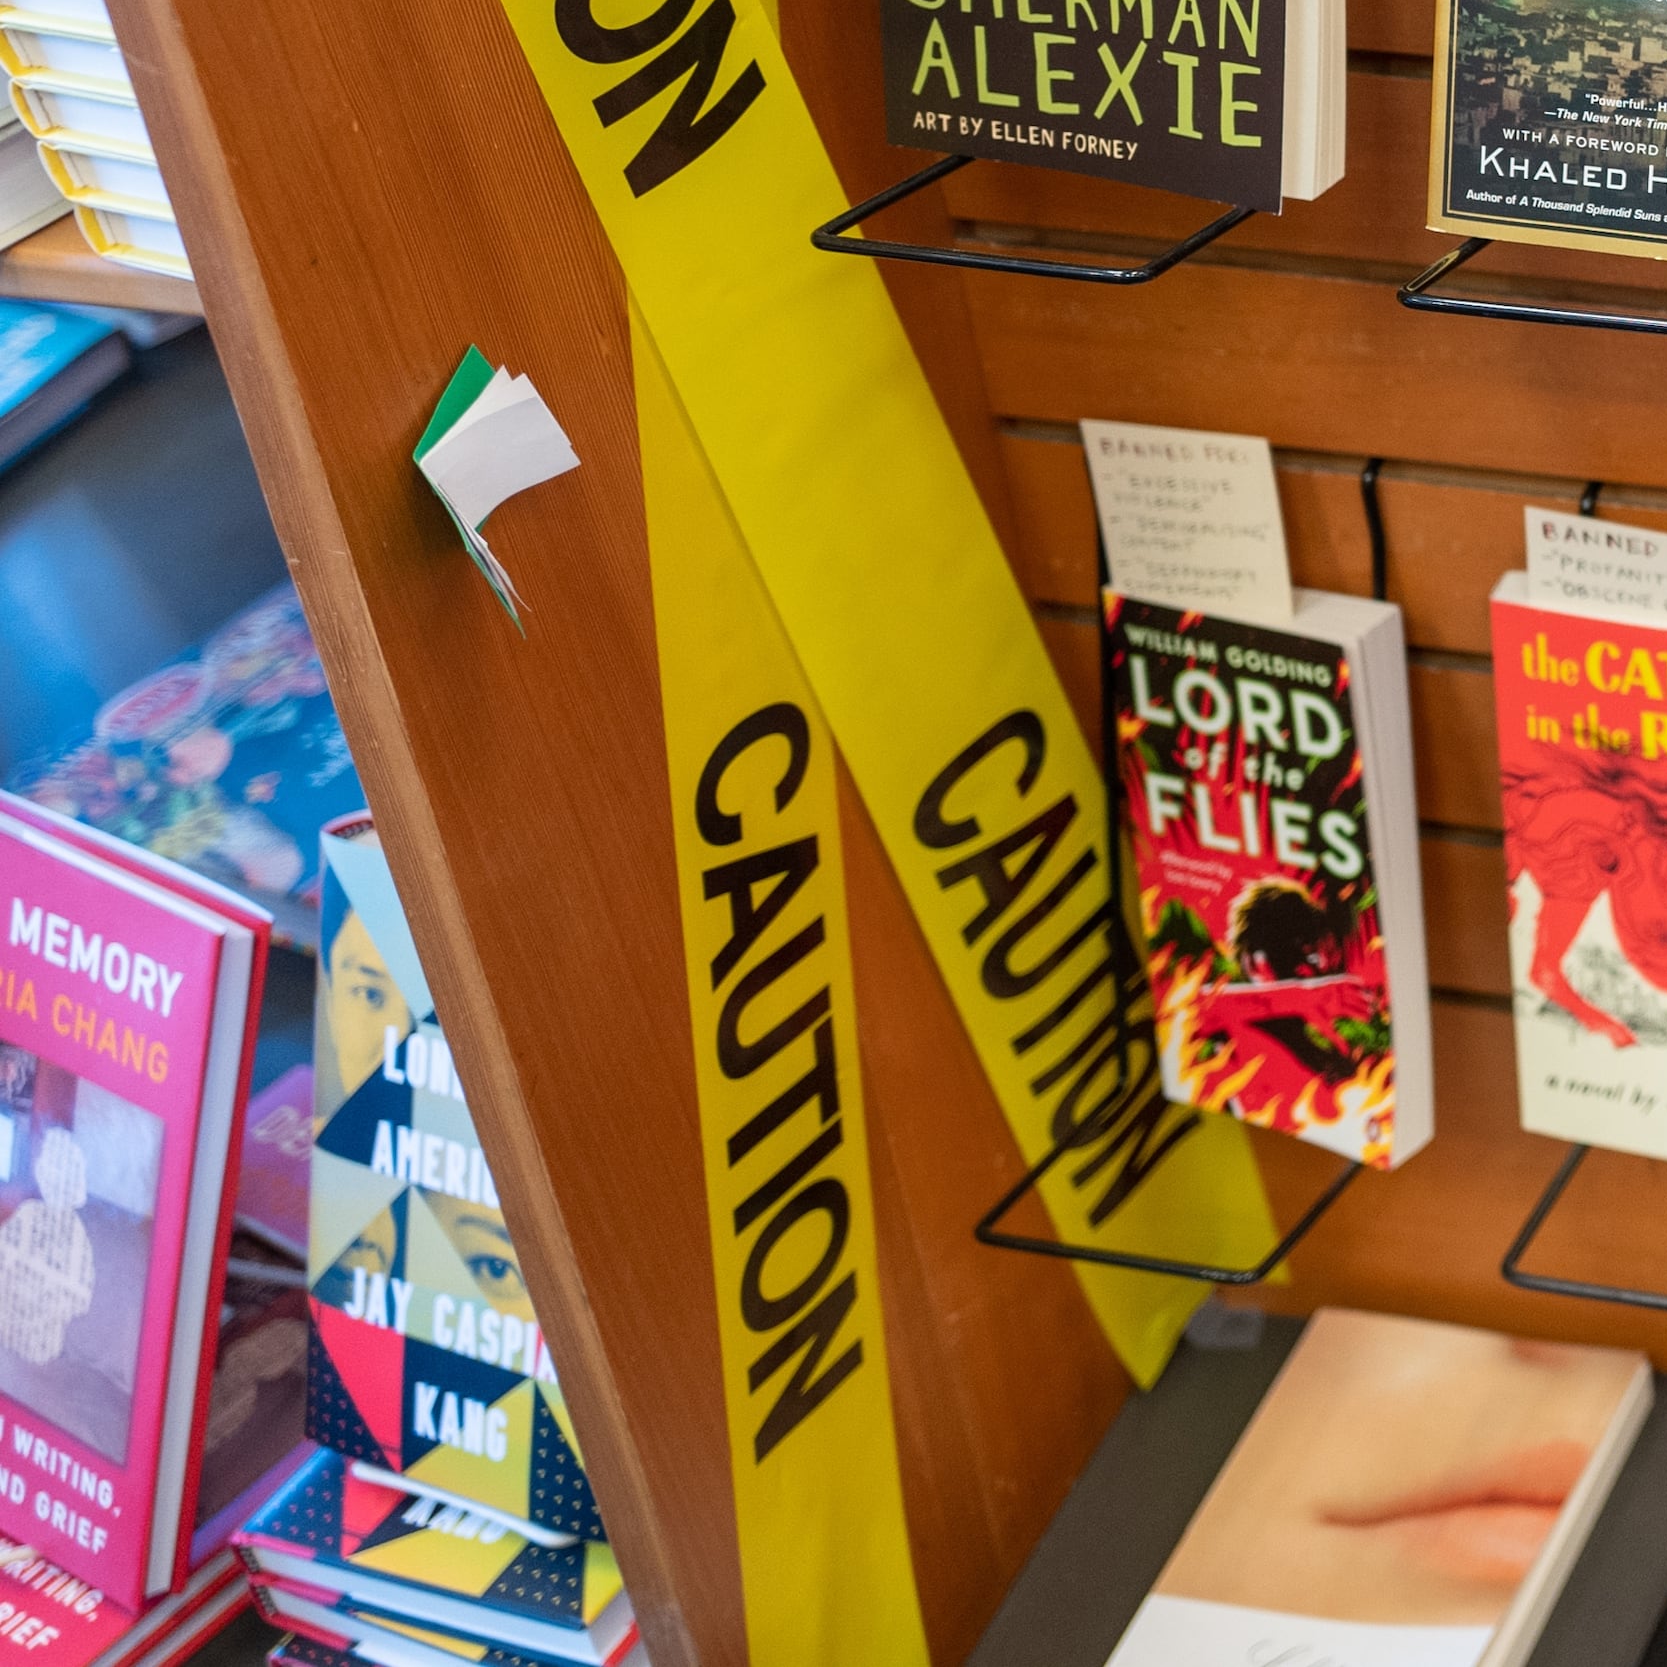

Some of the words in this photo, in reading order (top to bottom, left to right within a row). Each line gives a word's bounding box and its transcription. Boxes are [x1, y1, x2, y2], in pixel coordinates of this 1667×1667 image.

[912, 17, 1262, 147] ALEXIE
[913, 112, 951, 132] ART
[959, 117, 984, 136] BY
[991, 121, 1054, 148] ELLEN
[1062, 132, 1139, 160] FORNEY
[1480, 145, 1628, 191] KHALED
[1124, 623, 1218, 662] WILLIAM
[1226, 645, 1332, 688] GOLDING
[1522, 633, 1578, 686] the
[1130, 654, 1348, 759] LORD
[1526, 705, 1561, 743] in
[1571, 704, 1630, 754] the
[1184, 741, 1228, 779] of
[1243, 753, 1305, 790] the
[1144, 772, 1363, 879] FLIES
[6, 896, 184, 1017] MEMORY
[912, 706, 1205, 1230] CAUTION
[50, 996, 169, 1084] CHANG
[694, 701, 865, 1467] CAUTION
[344, 1266, 412, 1335] JAY
[412, 1381, 508, 1464] KANG
